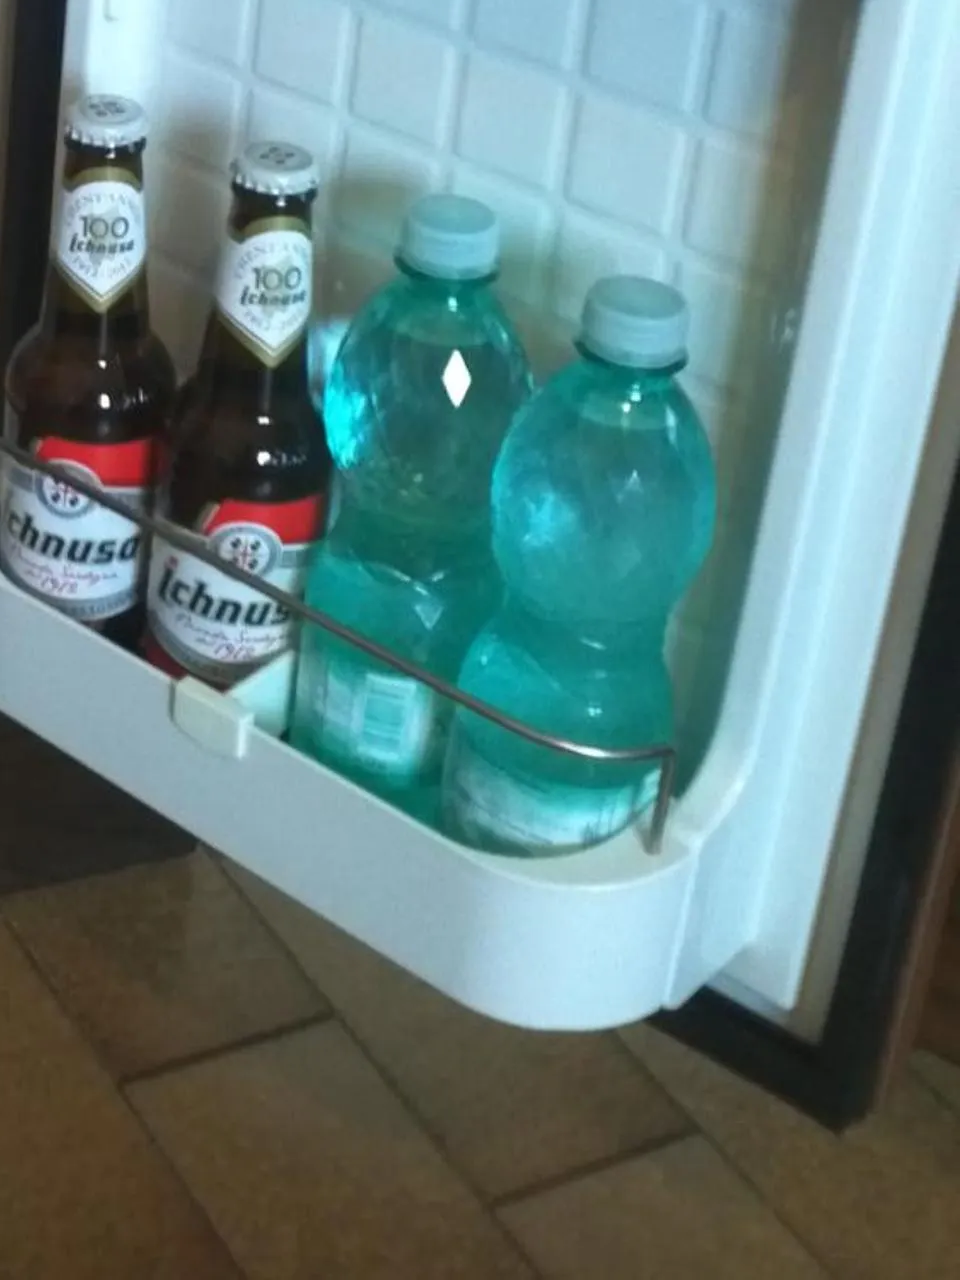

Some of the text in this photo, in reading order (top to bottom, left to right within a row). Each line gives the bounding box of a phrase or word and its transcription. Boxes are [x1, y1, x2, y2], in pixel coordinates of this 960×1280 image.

[80, 216, 130, 239] 100
[253, 267, 302, 290] 100
[7, 510, 139, 565] chnusa
[158, 556, 290, 628] ichnus
